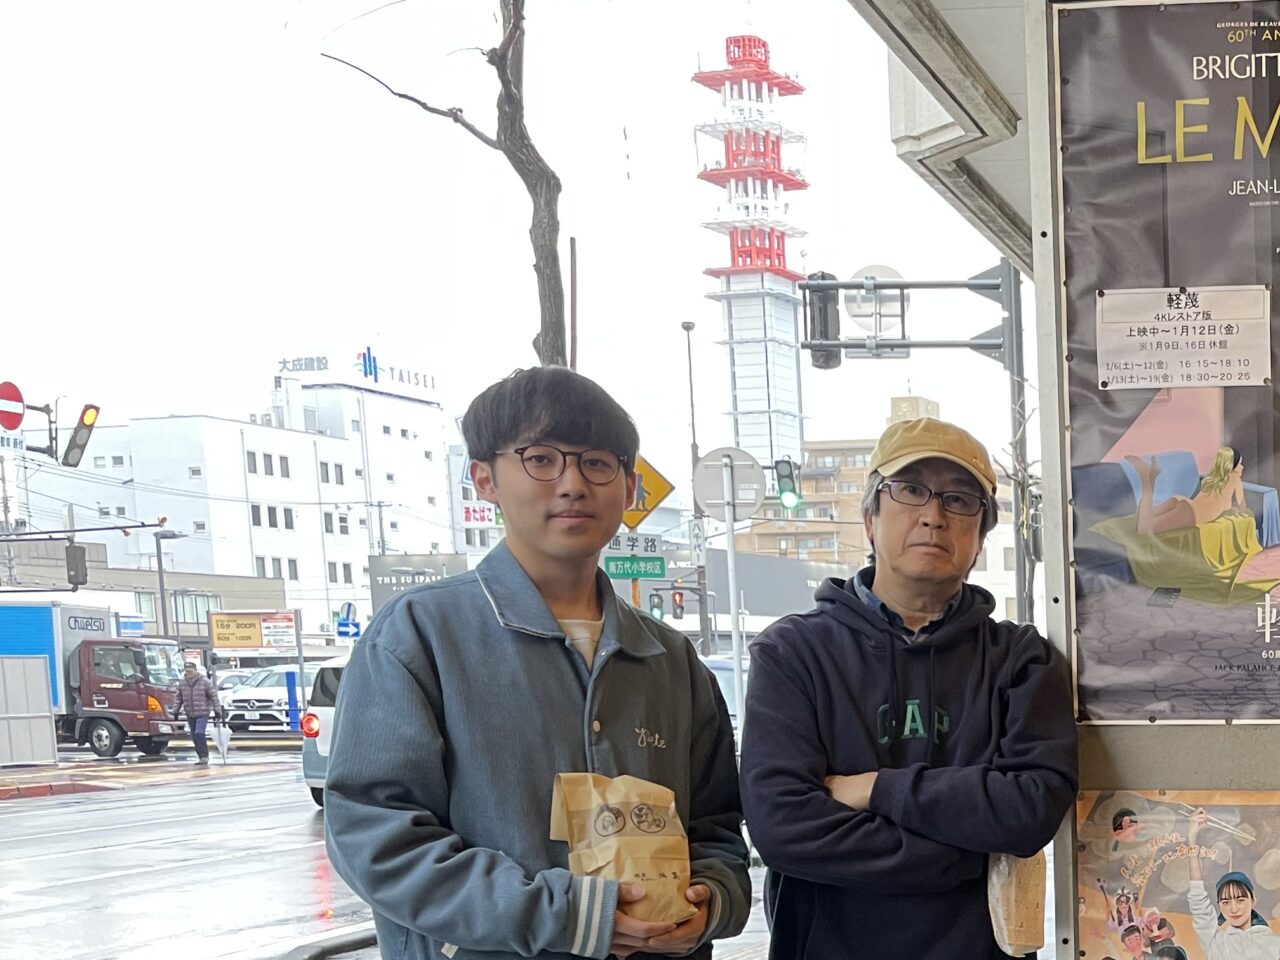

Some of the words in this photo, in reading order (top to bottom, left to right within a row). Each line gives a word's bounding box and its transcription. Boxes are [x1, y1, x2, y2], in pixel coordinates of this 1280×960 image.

[1136, 97, 1214, 165] LE
[1166, 292, 1200, 310] 軽蔑
[1154, 310, 1213, 322] 4Kレストア版
[278, 356, 329, 372] 大成建設
[389, 366, 435, 389] TAISEI
[608, 536, 657, 553] 通学路
